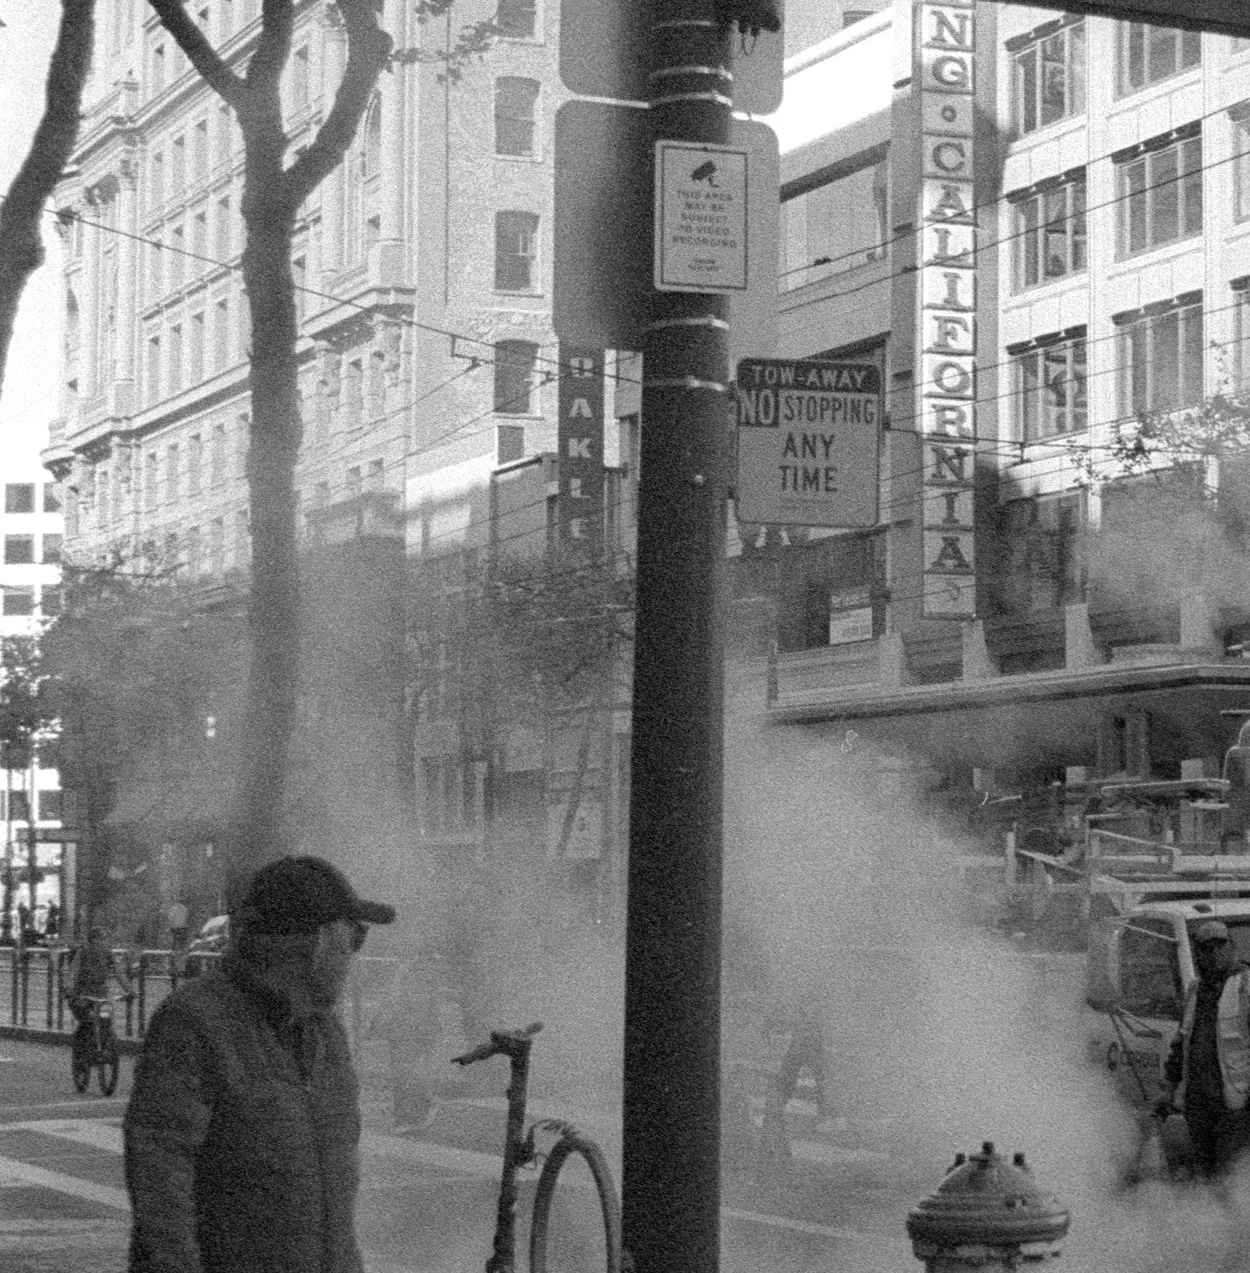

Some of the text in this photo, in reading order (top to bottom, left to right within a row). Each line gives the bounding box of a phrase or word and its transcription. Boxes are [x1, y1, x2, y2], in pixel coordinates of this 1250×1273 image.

[704, 191, 733, 202] AREA
[681, 212, 728, 224] SUBJECT
[672, 235, 737, 249] RECORDING
[696, 226, 731, 237] VIDEO
[929, 142, 972, 572] CALIFORNIA
[751, 365, 867, 388] TOW-AWAY
[741, 389, 875, 425] NO STOPPING
[782, 432, 836, 460] ANY
[779, 465, 839, 493] TIME
